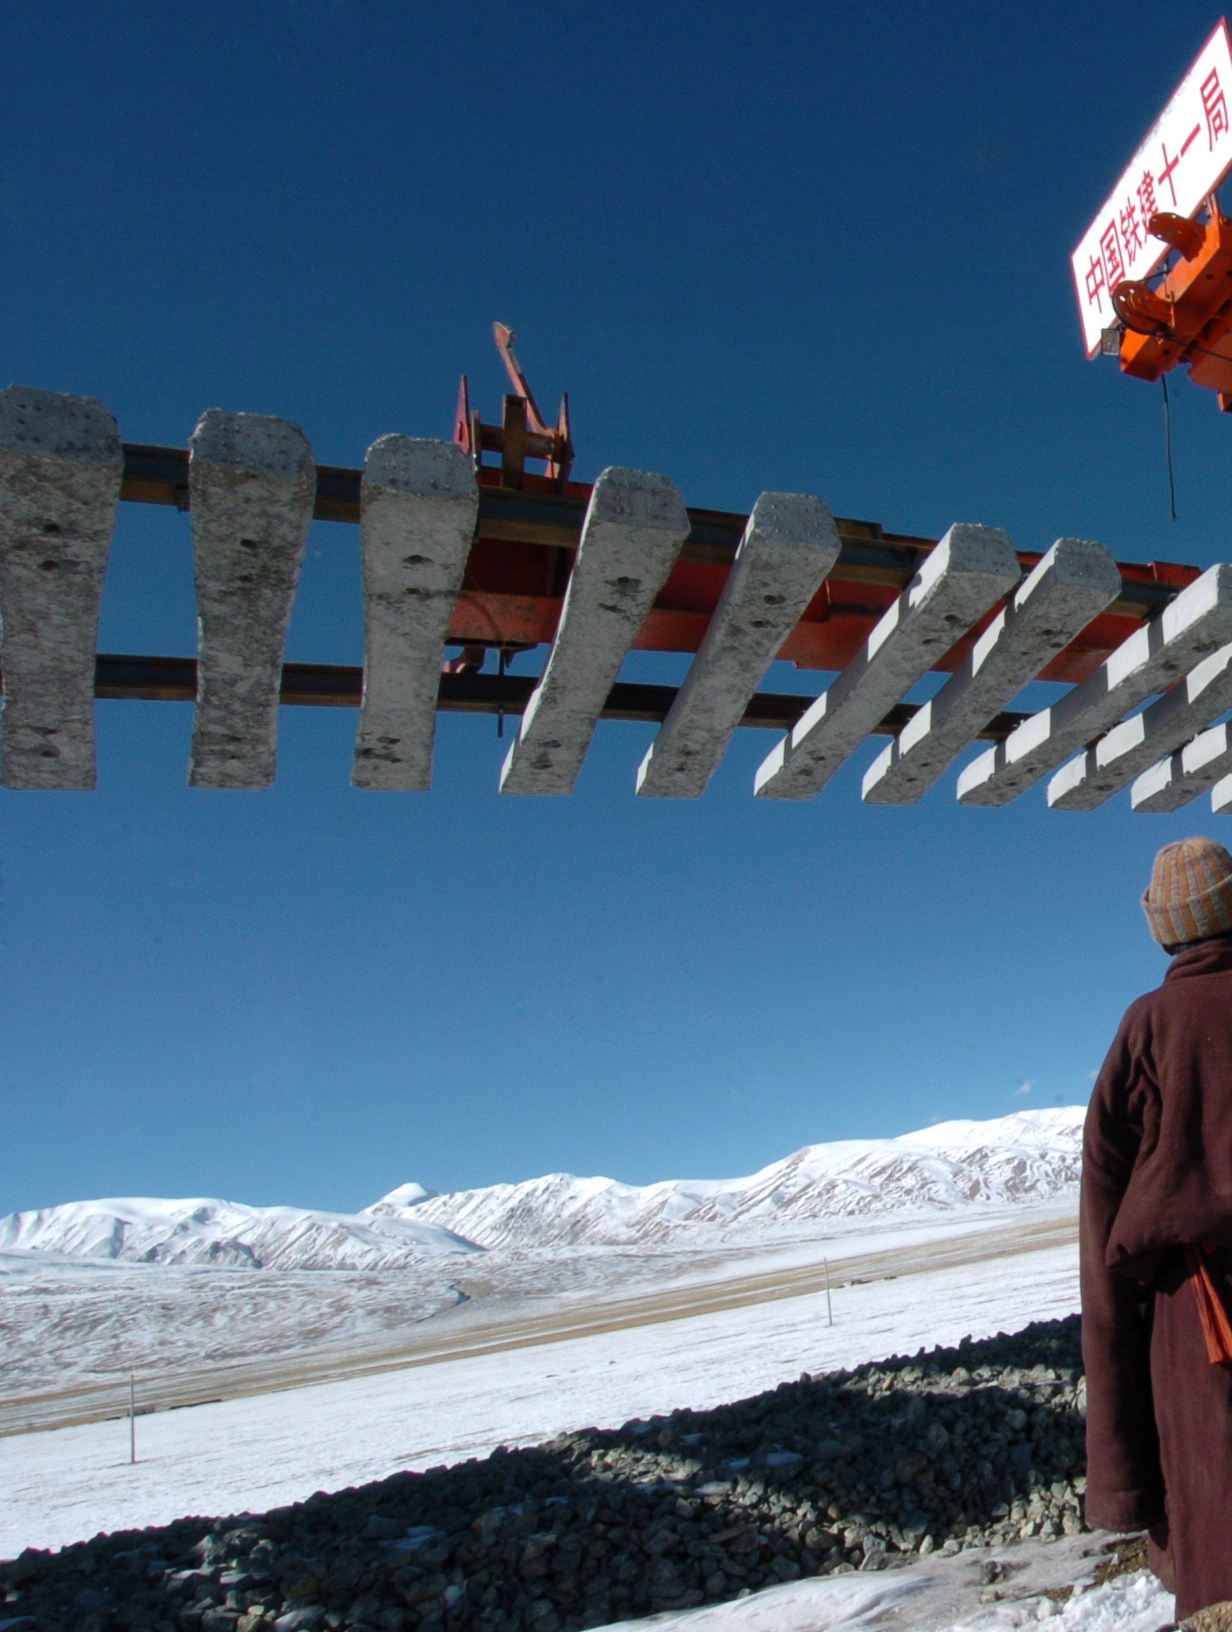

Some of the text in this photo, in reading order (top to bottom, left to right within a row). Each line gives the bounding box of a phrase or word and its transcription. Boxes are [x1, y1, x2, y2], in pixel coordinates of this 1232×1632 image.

[1086, 66, 1229, 314] 中国铁建十一局
